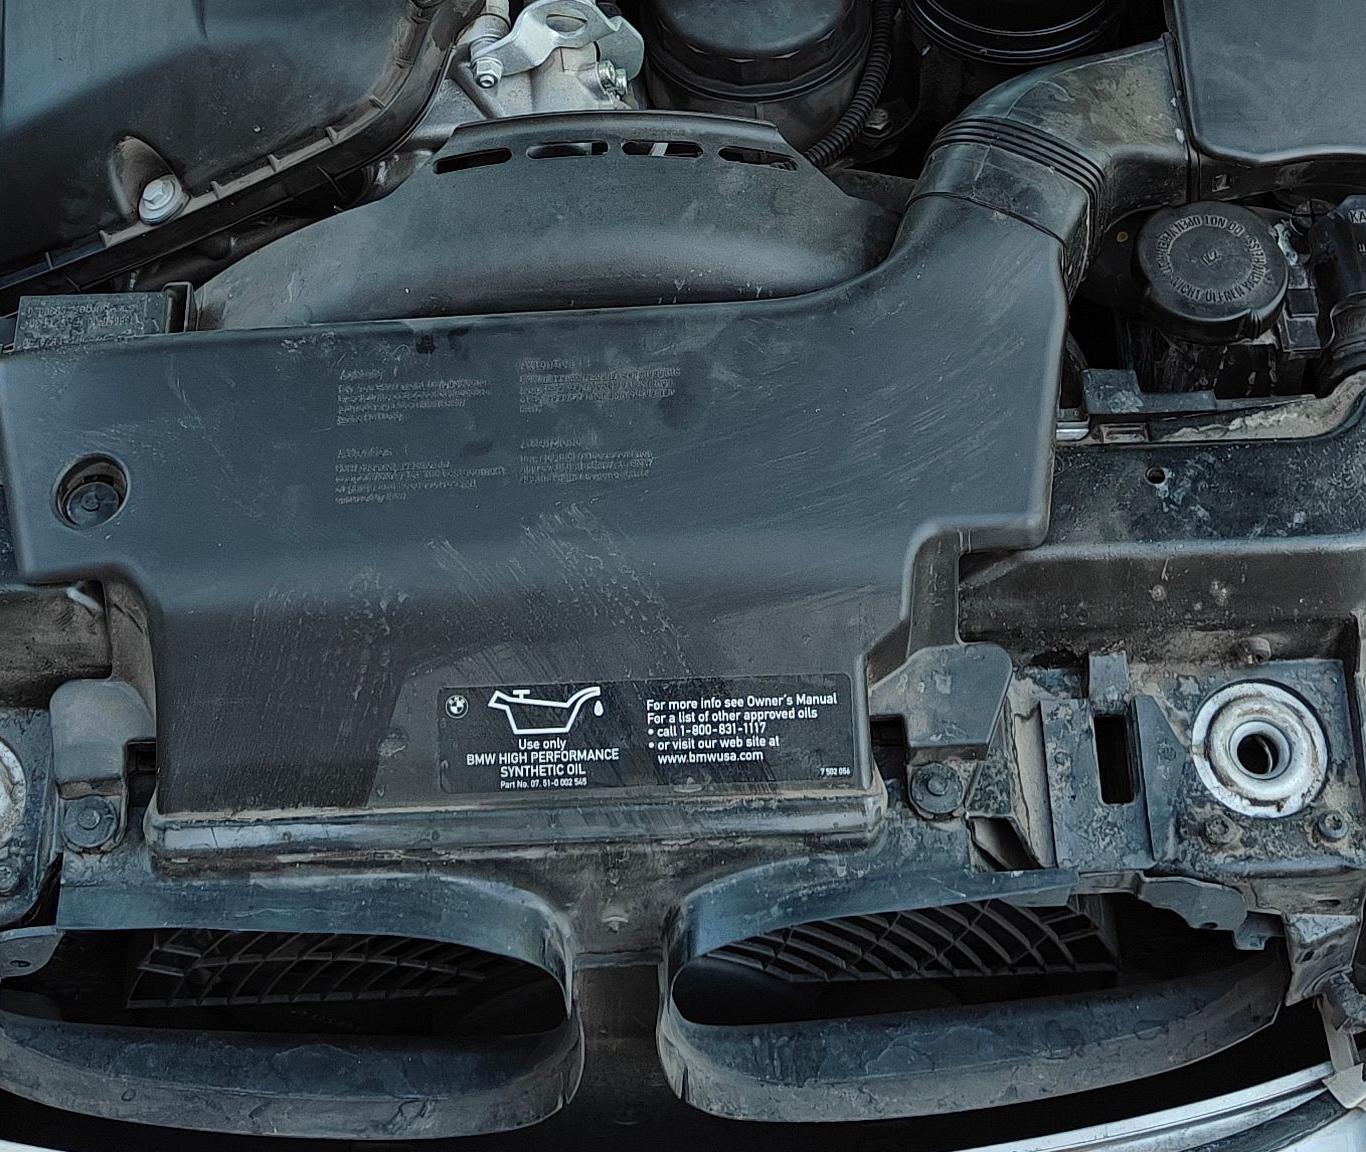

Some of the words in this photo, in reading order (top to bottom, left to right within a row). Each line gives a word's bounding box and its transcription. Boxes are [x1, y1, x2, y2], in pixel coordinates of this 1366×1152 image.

[646, 699, 666, 711] For
[669, 700, 698, 710] more
[700, 697, 722, 709] info
[724, 698, 744, 708] see
[746, 694, 793, 707] Owner's
[796, 692, 838, 706] Manual
[647, 712, 666, 724] For
[678, 711, 695, 723] list
[698, 711, 709, 722] of
[711, 710, 741, 722] other
[743, 708, 795, 724] approved
[797, 707, 818, 719] oils
[657, 725, 677, 737] call
[680, 722, 766, 736] 1-800-831-1117
[518, 738, 540, 750] Use
[542, 737, 567, 751] only
[657, 741, 669, 750] or
[672, 737, 695, 750] visit
[698, 739, 718, 749] our
[719, 735, 743, 748] web
[745, 735, 766, 748] site
[768, 735, 780, 747] at
[466, 753, 496, 766] BMW
[499, 751, 527, 765] HIGH
[530, 748, 619, 764] PERFORMANCE
[657, 750, 764, 765] www.bmwusa.com
[500, 764, 564, 778] SYNTHETIC
[566, 763, 586, 775] OIL
[500, 780, 516, 789] Part
